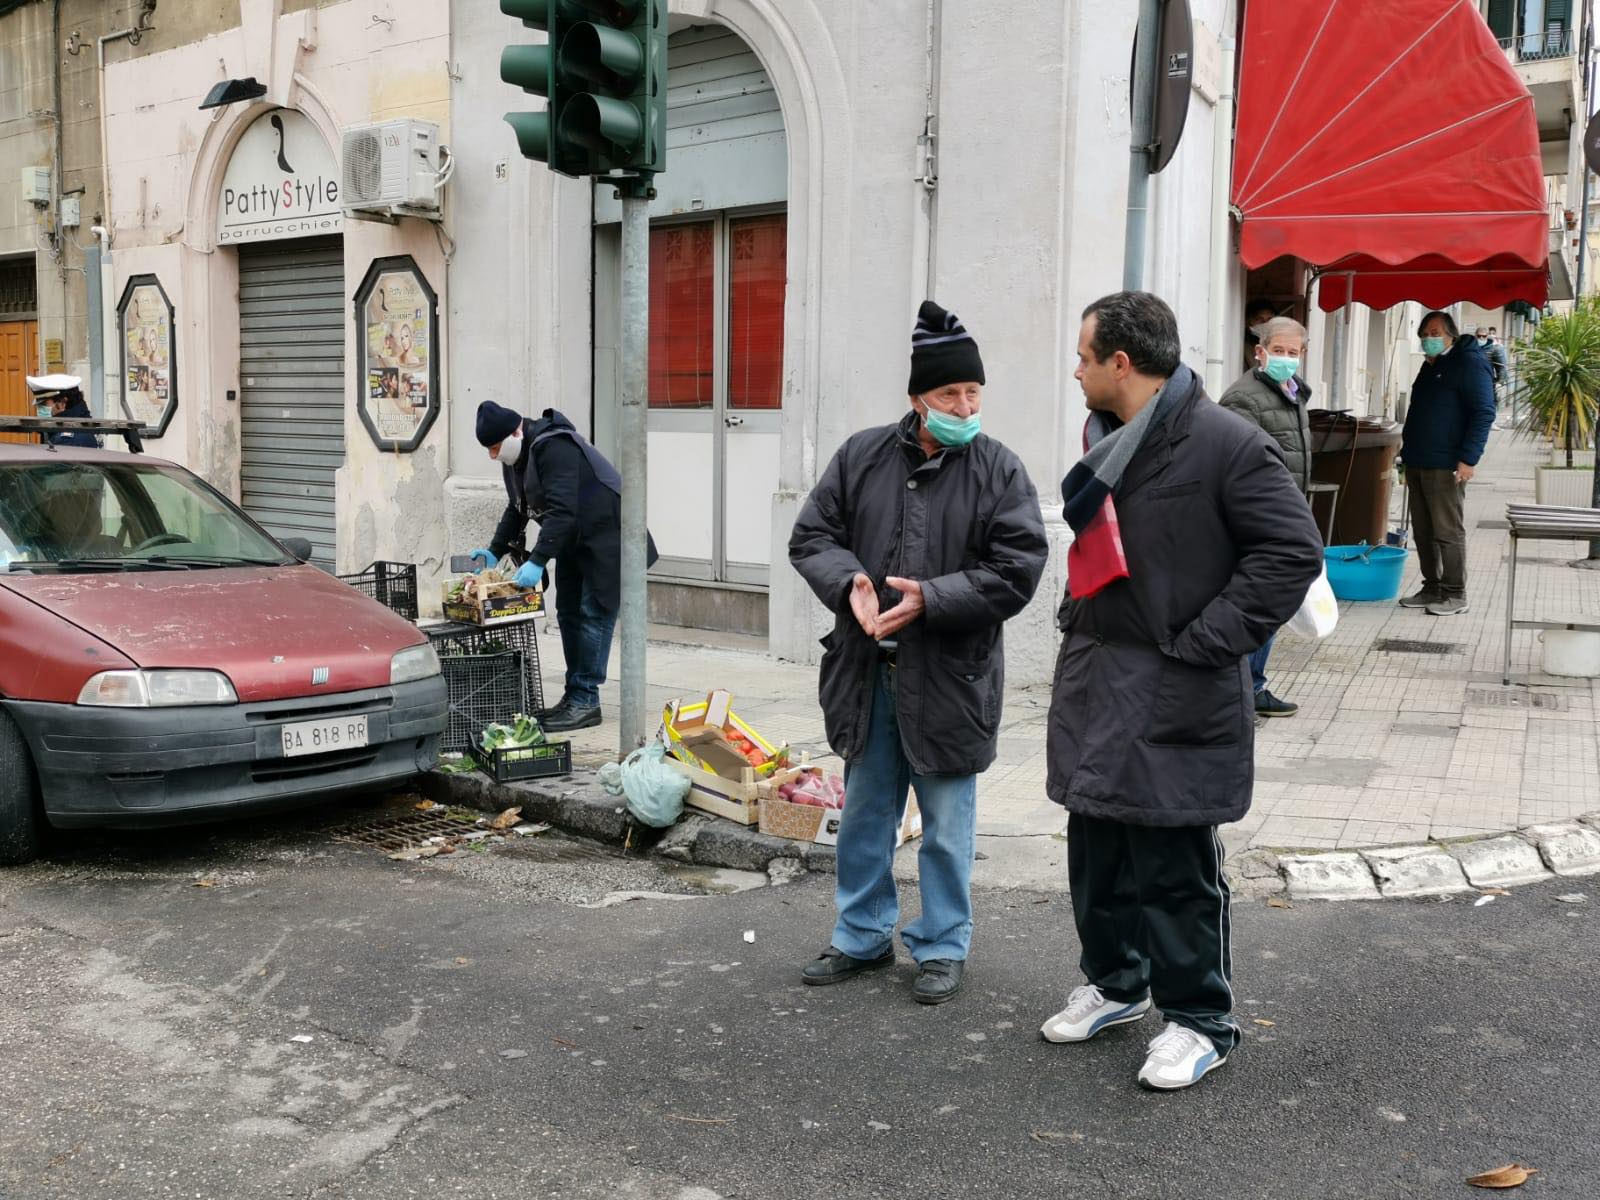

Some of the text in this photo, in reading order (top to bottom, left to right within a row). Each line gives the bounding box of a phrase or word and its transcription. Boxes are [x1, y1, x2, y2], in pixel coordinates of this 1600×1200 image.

[495, 163, 506, 179] 95
[284, 722, 366, 750] BA 818 RR
